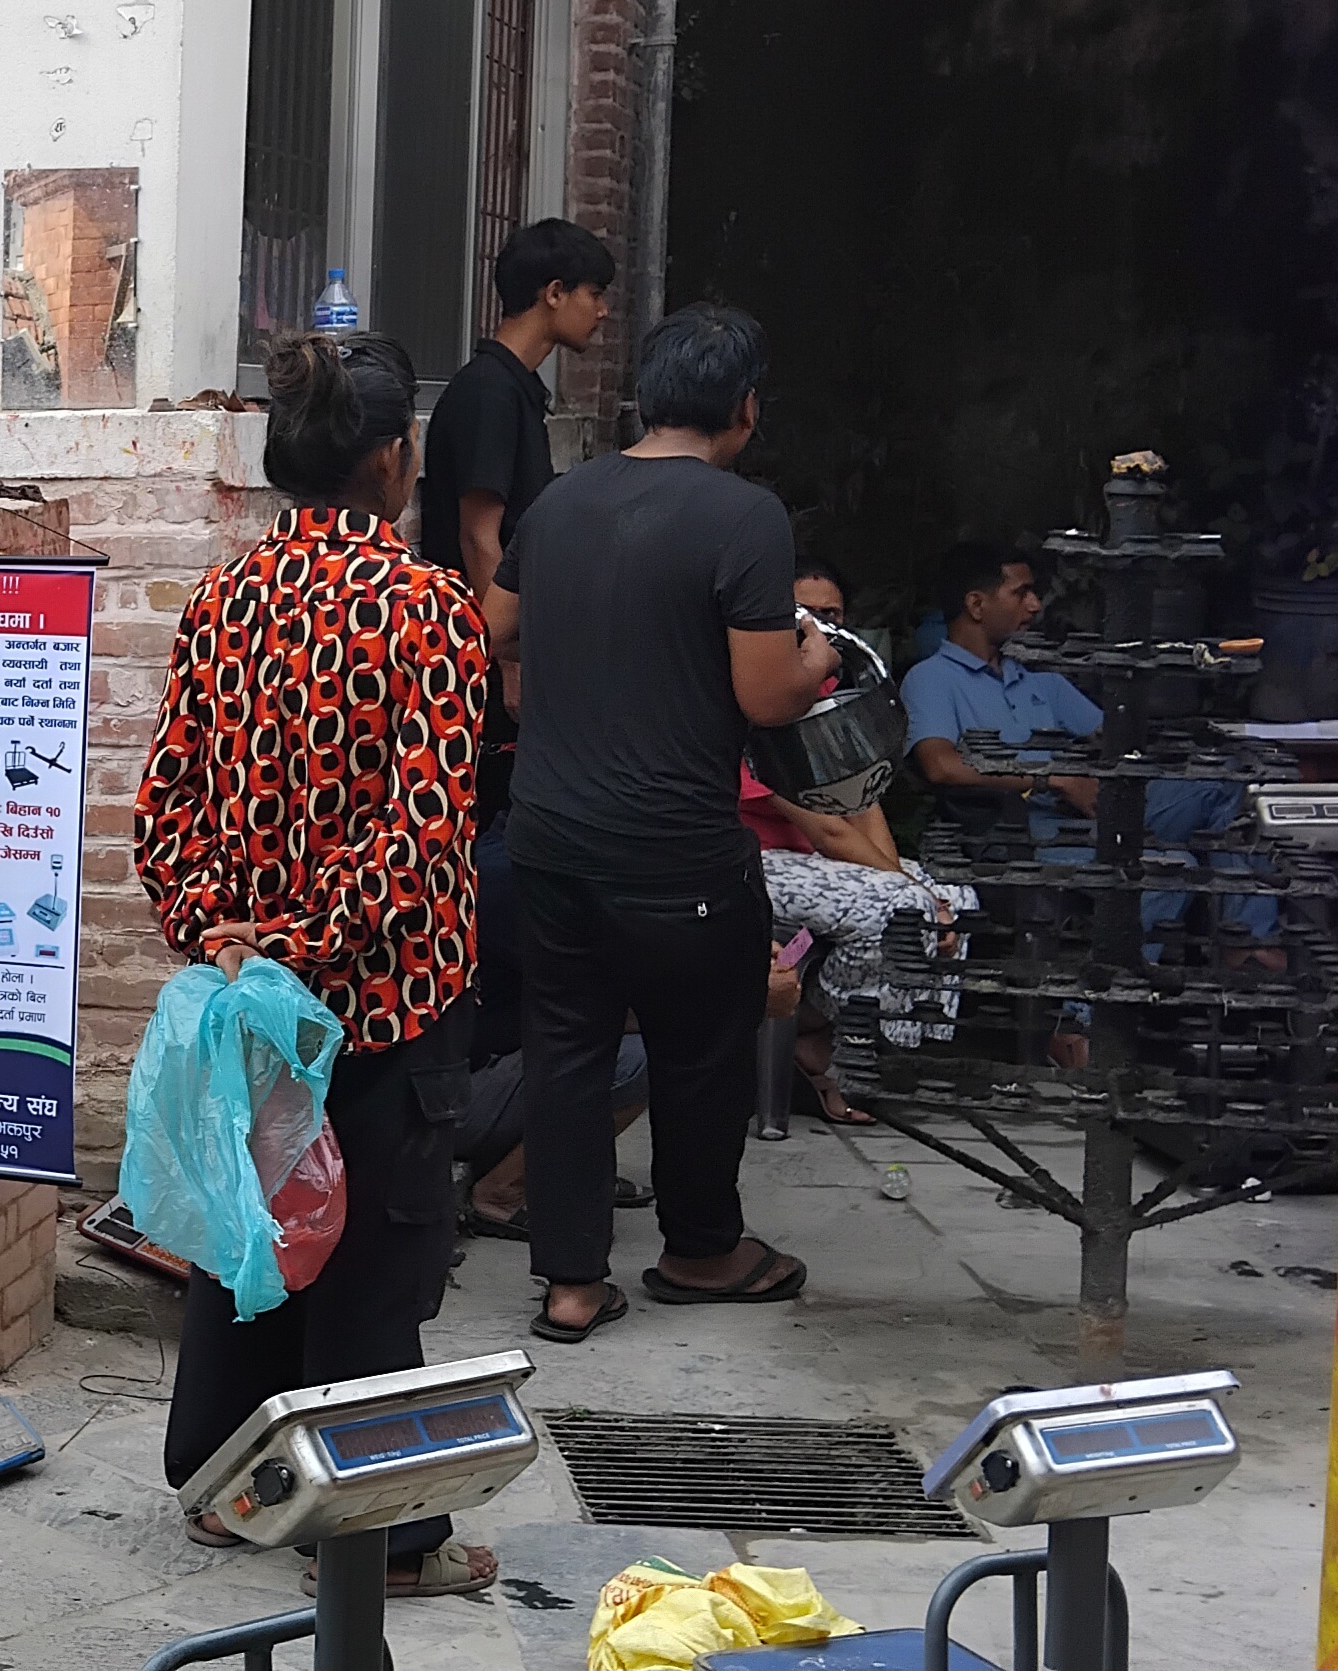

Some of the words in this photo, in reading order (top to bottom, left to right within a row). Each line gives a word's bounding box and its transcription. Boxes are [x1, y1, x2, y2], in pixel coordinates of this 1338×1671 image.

[5, 639, 47, 651] अन्तर्गत
[53, 642, 81, 652] बजार
[2, 658, 48, 670] व्यवसायी
[59, 661, 81, 671] तथा
[32, 678, 52, 689] दर्ता
[59, 681, 80, 690] तथा
[22, 695, 50, 708] निम्न
[53, 696, 76, 709] मिति
[38, 718, 77, 729] स्थानमा
[6, 800, 42, 817] बिहान
[46, 807, 61, 818] १०
[1, 968, 24, 983] होला
[26, 990, 46, 1003] बिल
[18, 1011, 46, 1023] प्रमाण
[26, 1097, 57, 1117] संघ
